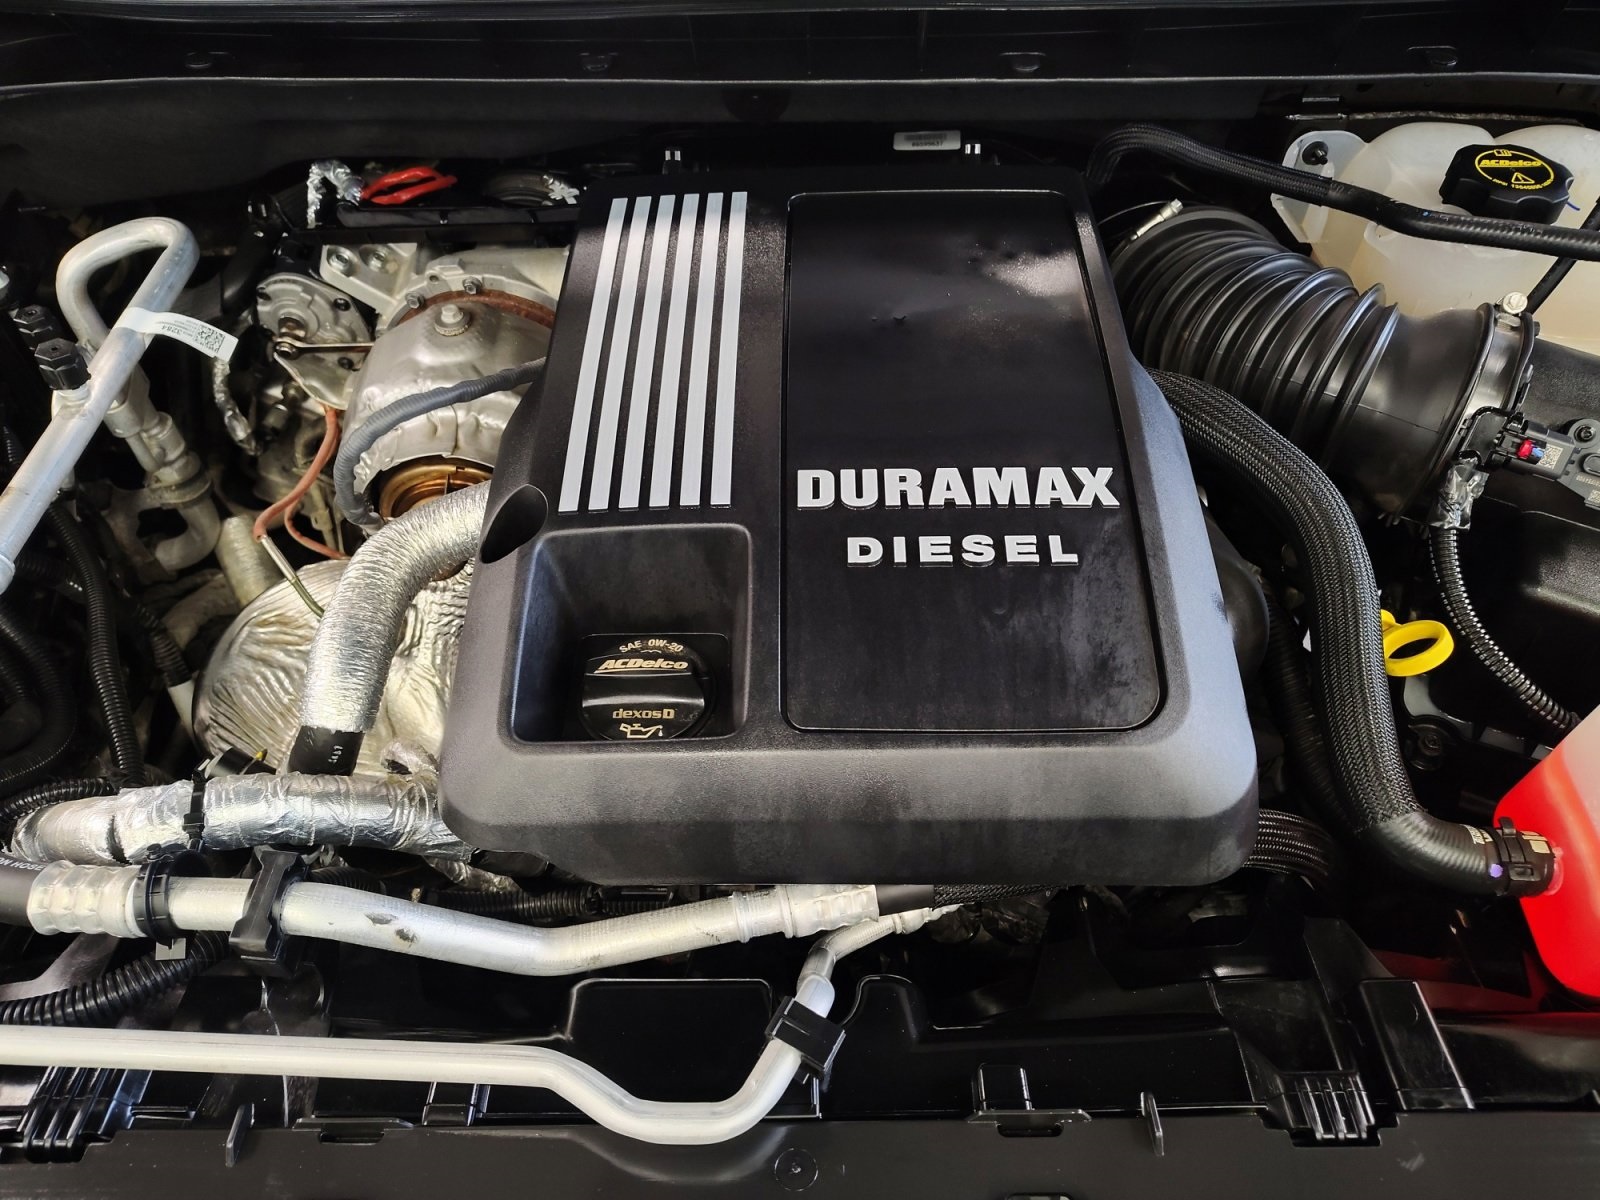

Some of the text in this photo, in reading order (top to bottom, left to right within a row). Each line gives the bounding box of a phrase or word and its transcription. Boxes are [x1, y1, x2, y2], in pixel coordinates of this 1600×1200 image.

[1480, 159, 1542, 168] ACDelco
[797, 467, 1121, 509] DURAMAX
[847, 534, 1079, 566] DIESEL
[619, 640, 642, 653] SAE
[598, 659, 689, 670] ACDelco
[612, 708, 675, 719] dexosD
